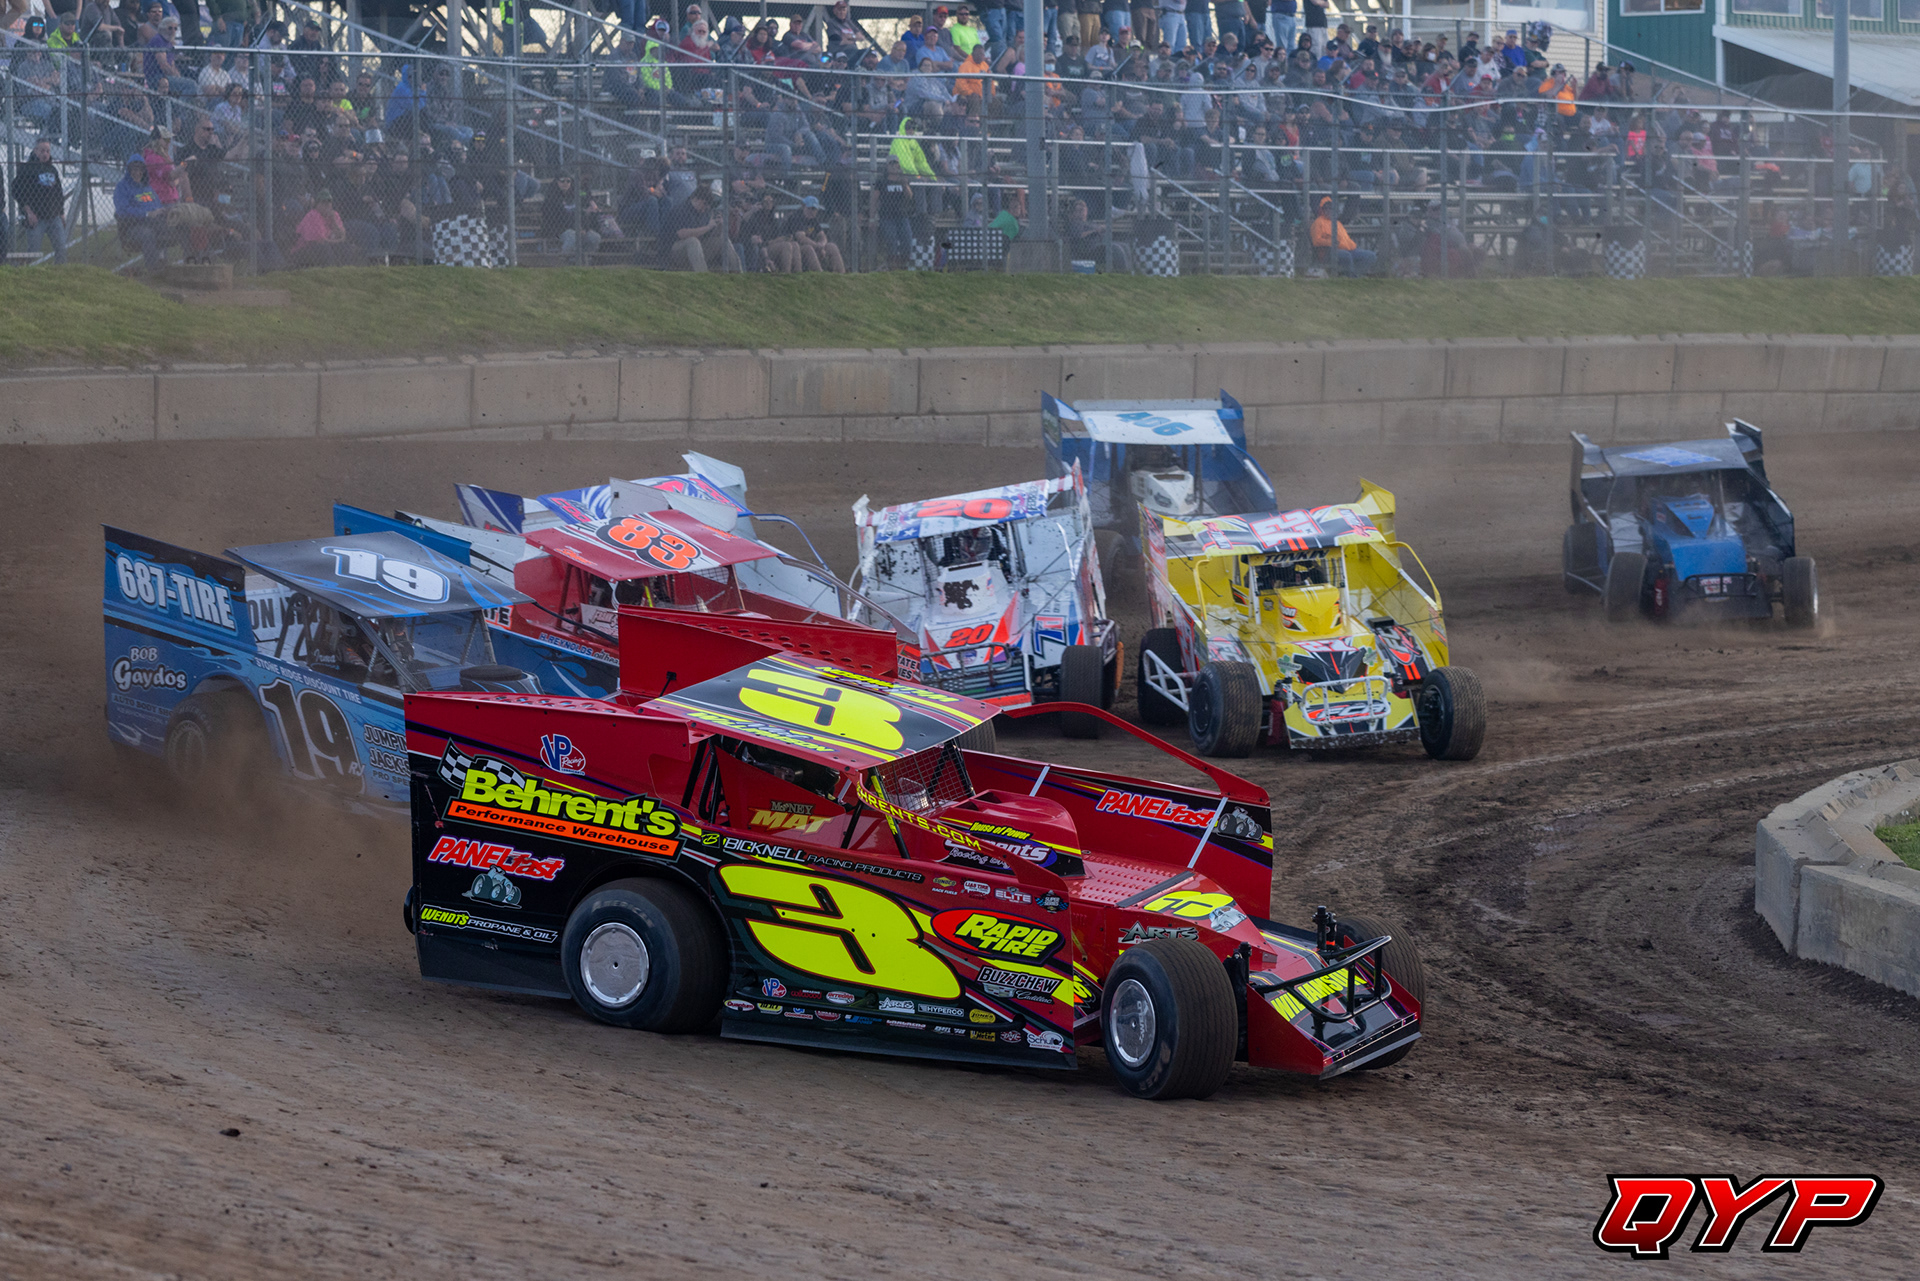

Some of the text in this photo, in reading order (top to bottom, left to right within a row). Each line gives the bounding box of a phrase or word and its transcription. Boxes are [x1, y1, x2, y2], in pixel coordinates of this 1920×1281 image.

[913, 498, 1013, 520] 20
[604, 517, 700, 570] 83
[1264, 550, 1330, 564] TONKIN
[320, 546, 450, 602] 19
[116, 553, 238, 635] 687-TIRE
[944, 623, 994, 648] 20
[130, 647, 158, 661] BOB
[114, 660, 186, 690] Gaydos
[256, 657, 361, 704] STONE RIDGE DISCOUNT TIRE
[738, 669, 904, 750] 3
[258, 678, 366, 795] 19
[541, 733, 572, 771] VP
[562, 756, 585, 768] Racing
[373, 770, 389, 781] PRO
[461, 769, 676, 835] Behrent's
[455, 805, 670, 851] Performance Warehouse
[751, 810, 832, 834] MAT
[428, 836, 565, 880] PANELfast
[724, 837, 922, 881] BICKNELL RACING PRODUCTS
[933, 877, 957, 887] SUNOCO
[995, 889, 1031, 903] ELITE
[421, 908, 469, 925] WENDT'S
[468, 919, 521, 935] PROPANE
[533, 931, 553, 940] OIL
[720, 865, 961, 999] 3
[955, 913, 1058, 946] RAPID
[1119, 920, 1199, 942] ARTS
[978, 935, 1047, 958] TIRE
[977, 967, 1060, 994] BUZZCHEW
[928, 1006, 963, 1016] HYPERCO
[1016, 990, 1053, 1004] Cadillac
